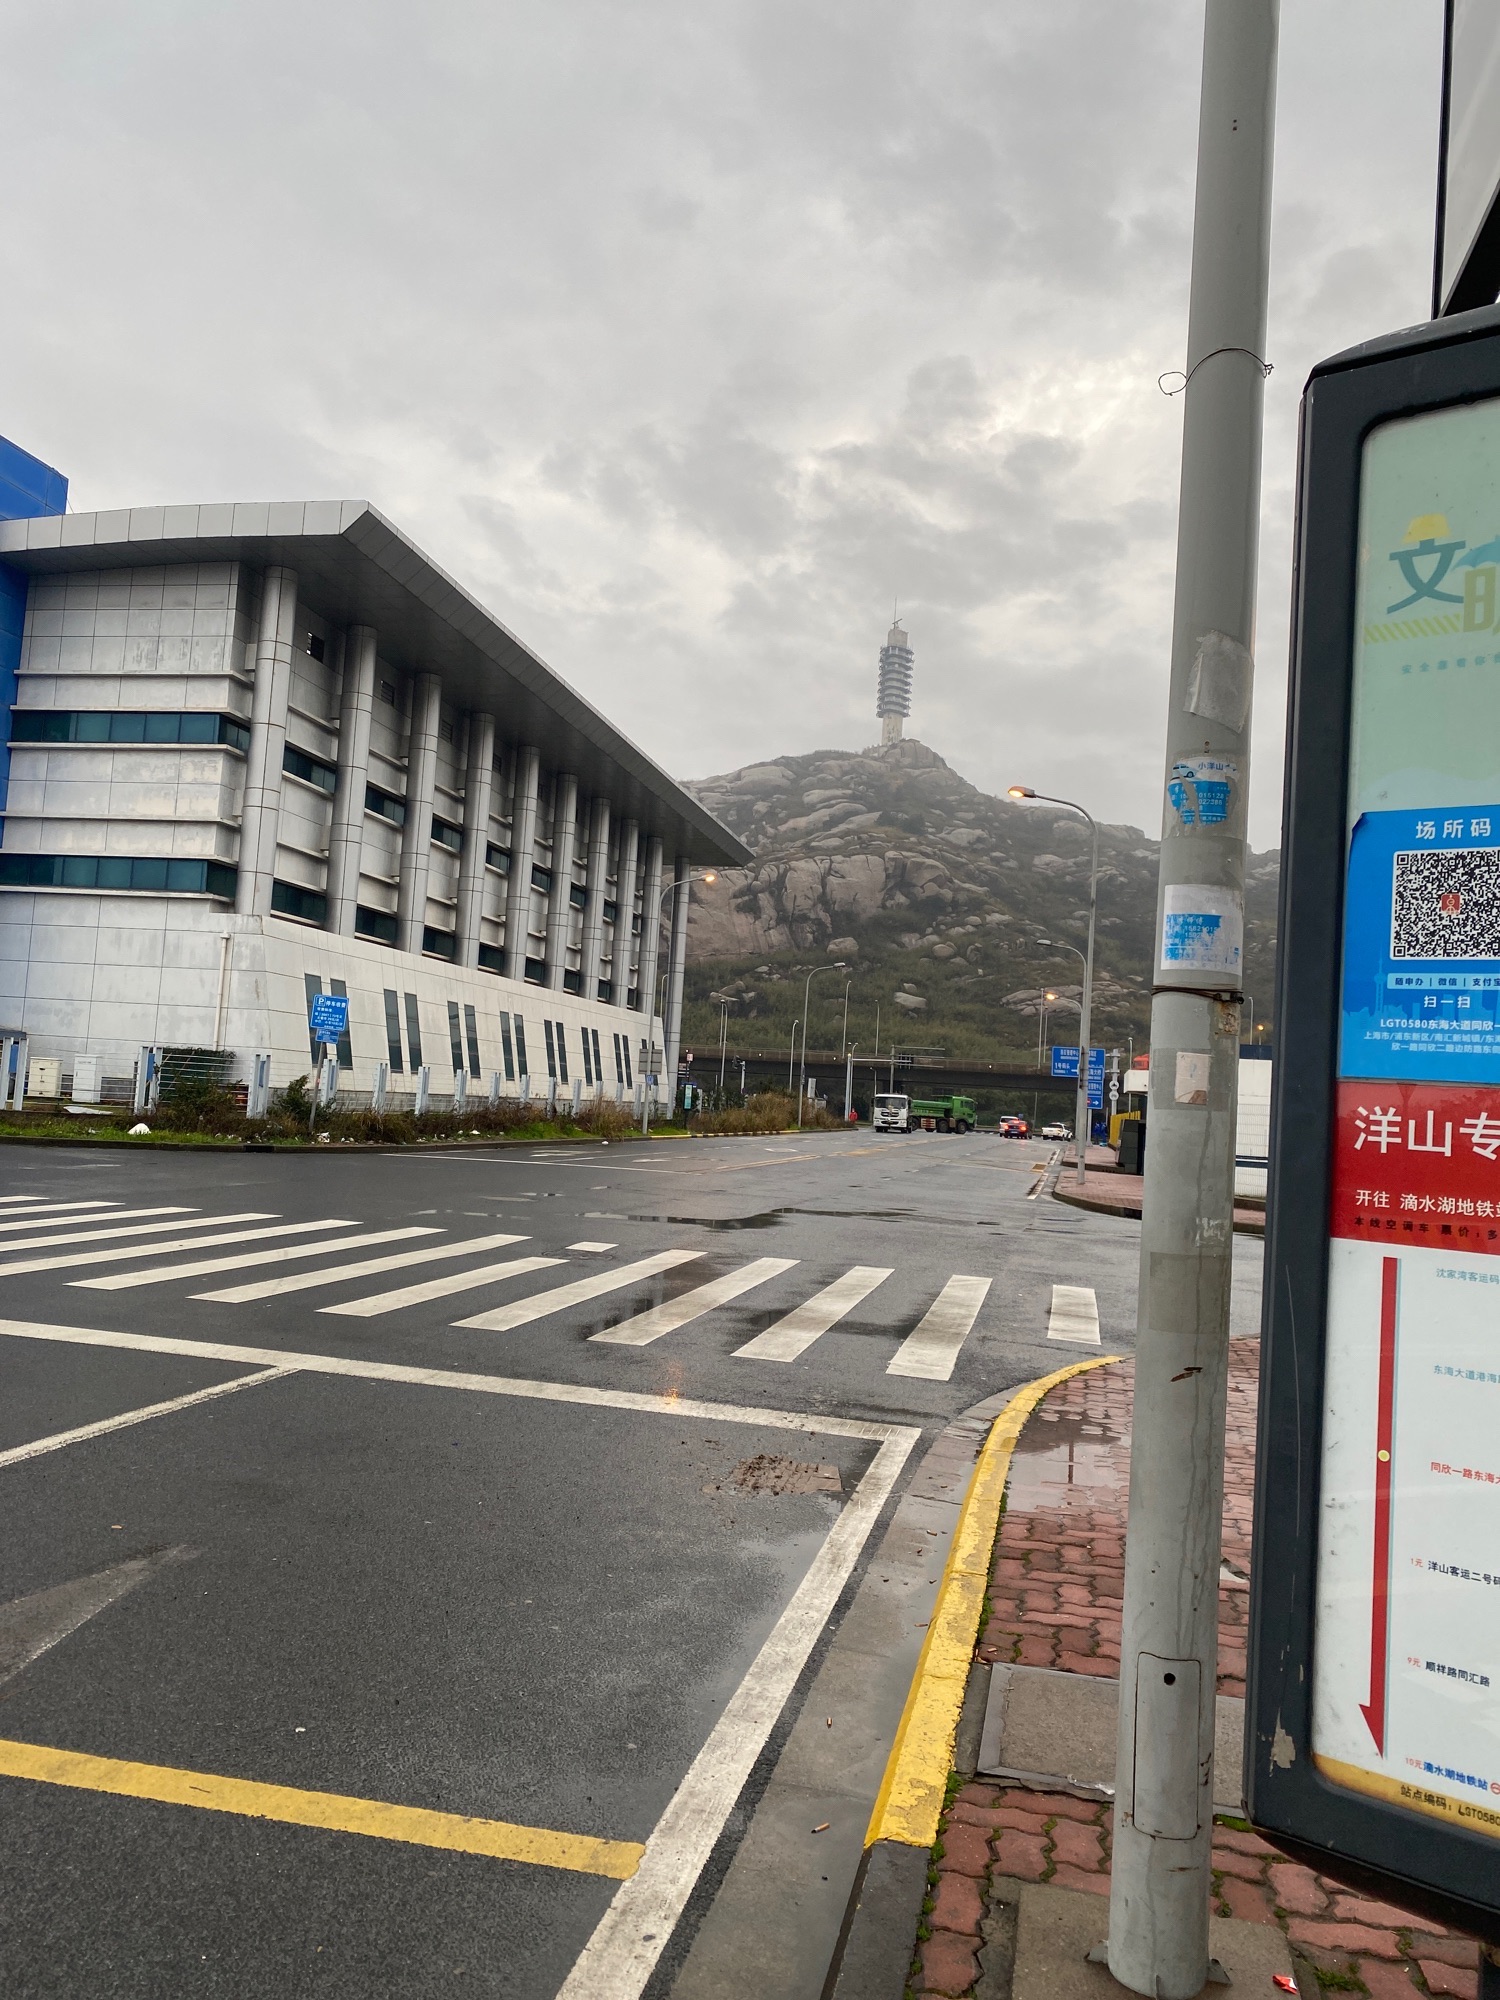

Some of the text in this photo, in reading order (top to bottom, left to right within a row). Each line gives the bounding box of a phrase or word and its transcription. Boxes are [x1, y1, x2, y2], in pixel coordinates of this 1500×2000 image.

[1415, 818, 1491, 840] 场所码
[1395, 977, 1424, 986] 随申办
[1438, 977, 1458, 987] 微信
[1424, 995, 1471, 1009] 扫一扫
[1353, 1106, 1500, 1160] 洋山专
[1355, 1189, 1390, 1208] 开往
[1425, 1660, 1491, 1687] 顺祥路同汇路
[1423, 1761, 1489, 1791] 滴水湖地铁站
